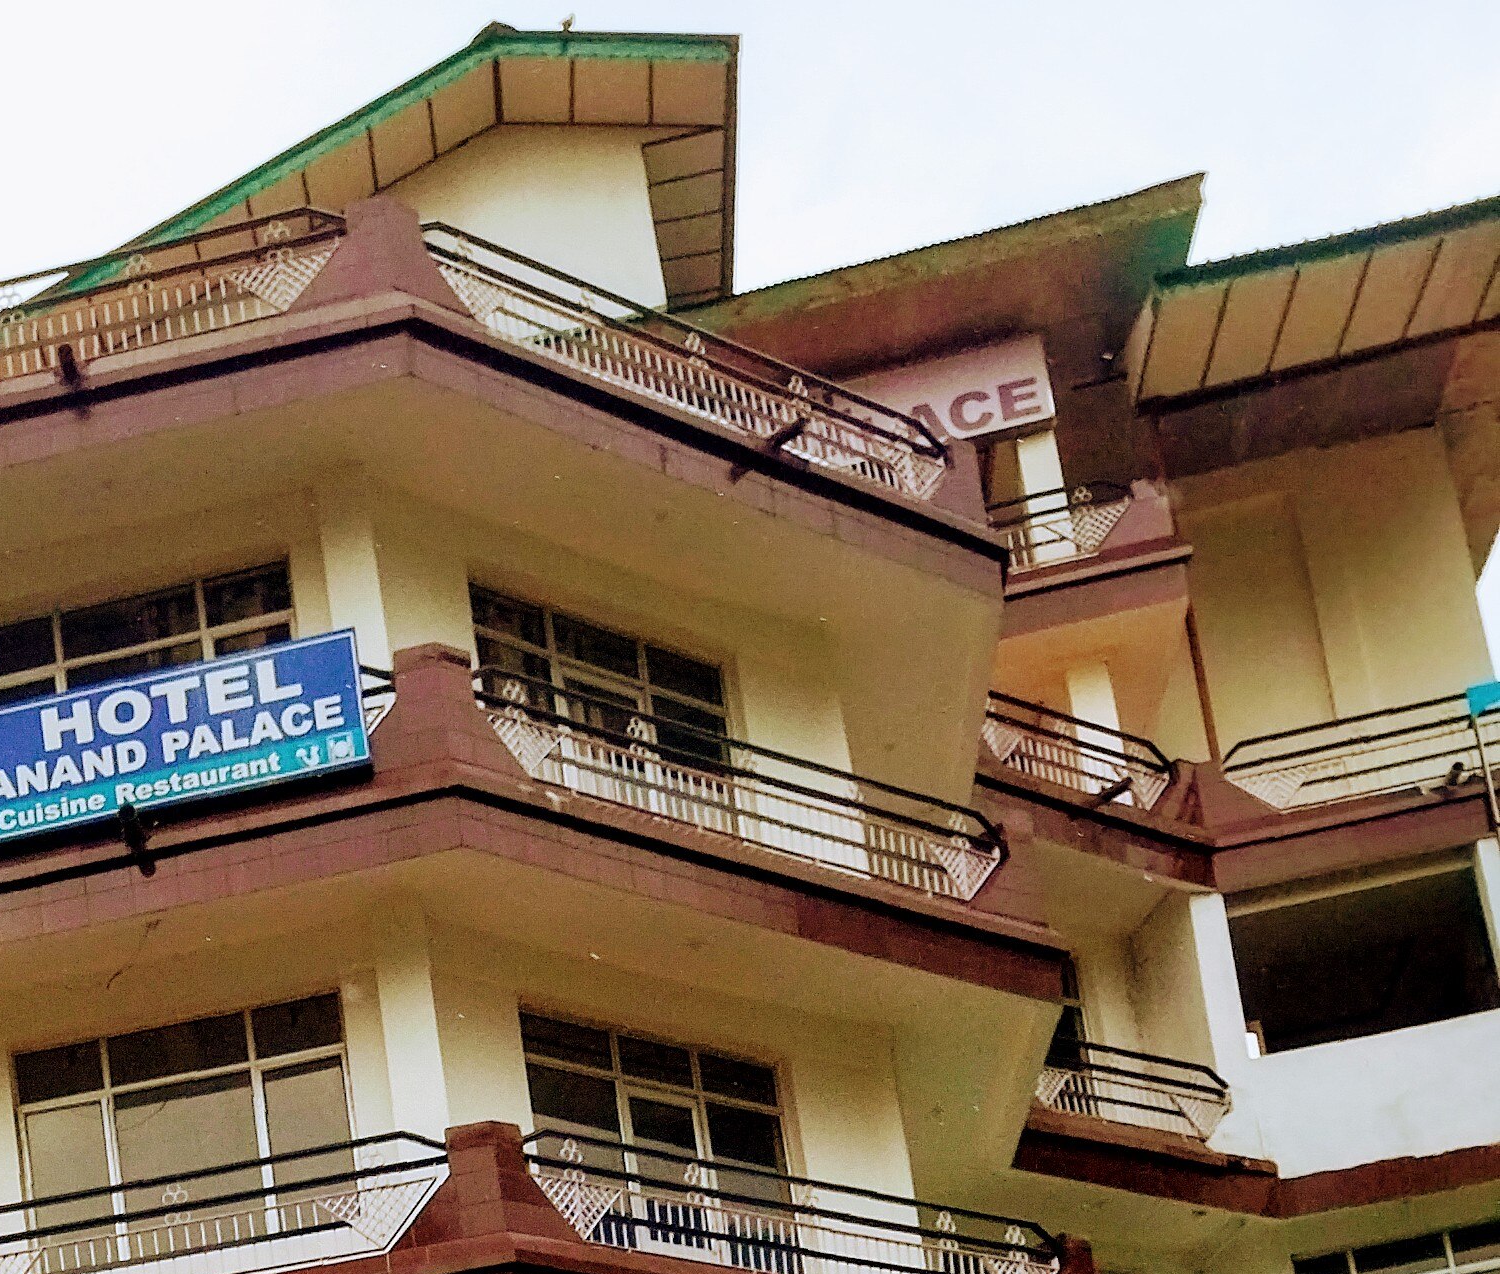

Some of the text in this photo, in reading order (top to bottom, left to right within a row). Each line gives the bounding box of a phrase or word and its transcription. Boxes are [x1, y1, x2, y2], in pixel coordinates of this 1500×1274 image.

[845, 376, 1041, 444] ACE
[41, 658, 304, 752] HOTEL
[161, 694, 346, 764] PALACE
[115, 750, 282, 806] Restaurant
